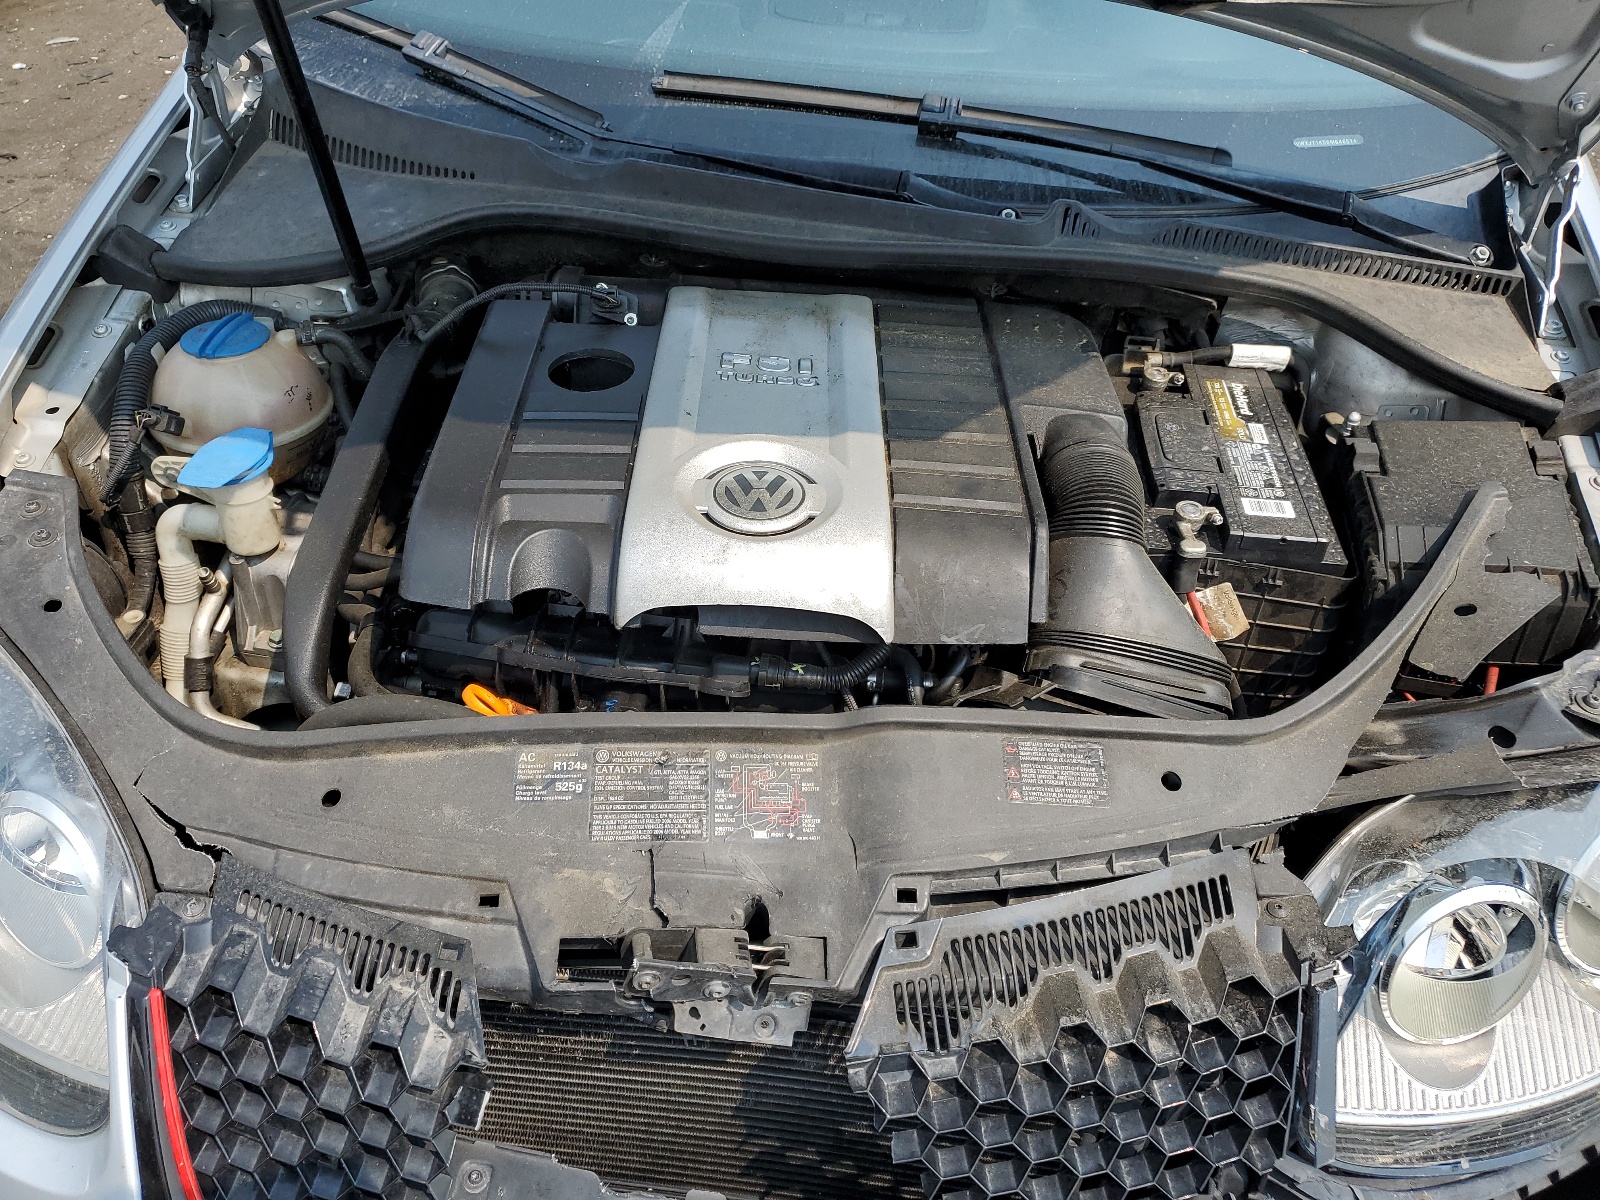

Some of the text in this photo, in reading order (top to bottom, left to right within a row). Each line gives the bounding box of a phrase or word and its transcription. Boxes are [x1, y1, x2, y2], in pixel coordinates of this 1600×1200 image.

[1231, 383, 1254, 416] DieHard
[519, 752, 536, 762] AC
[554, 761, 588, 770] R134a
[596, 766, 643, 774] CATALYST
[555, 782, 583, 793] 525g
